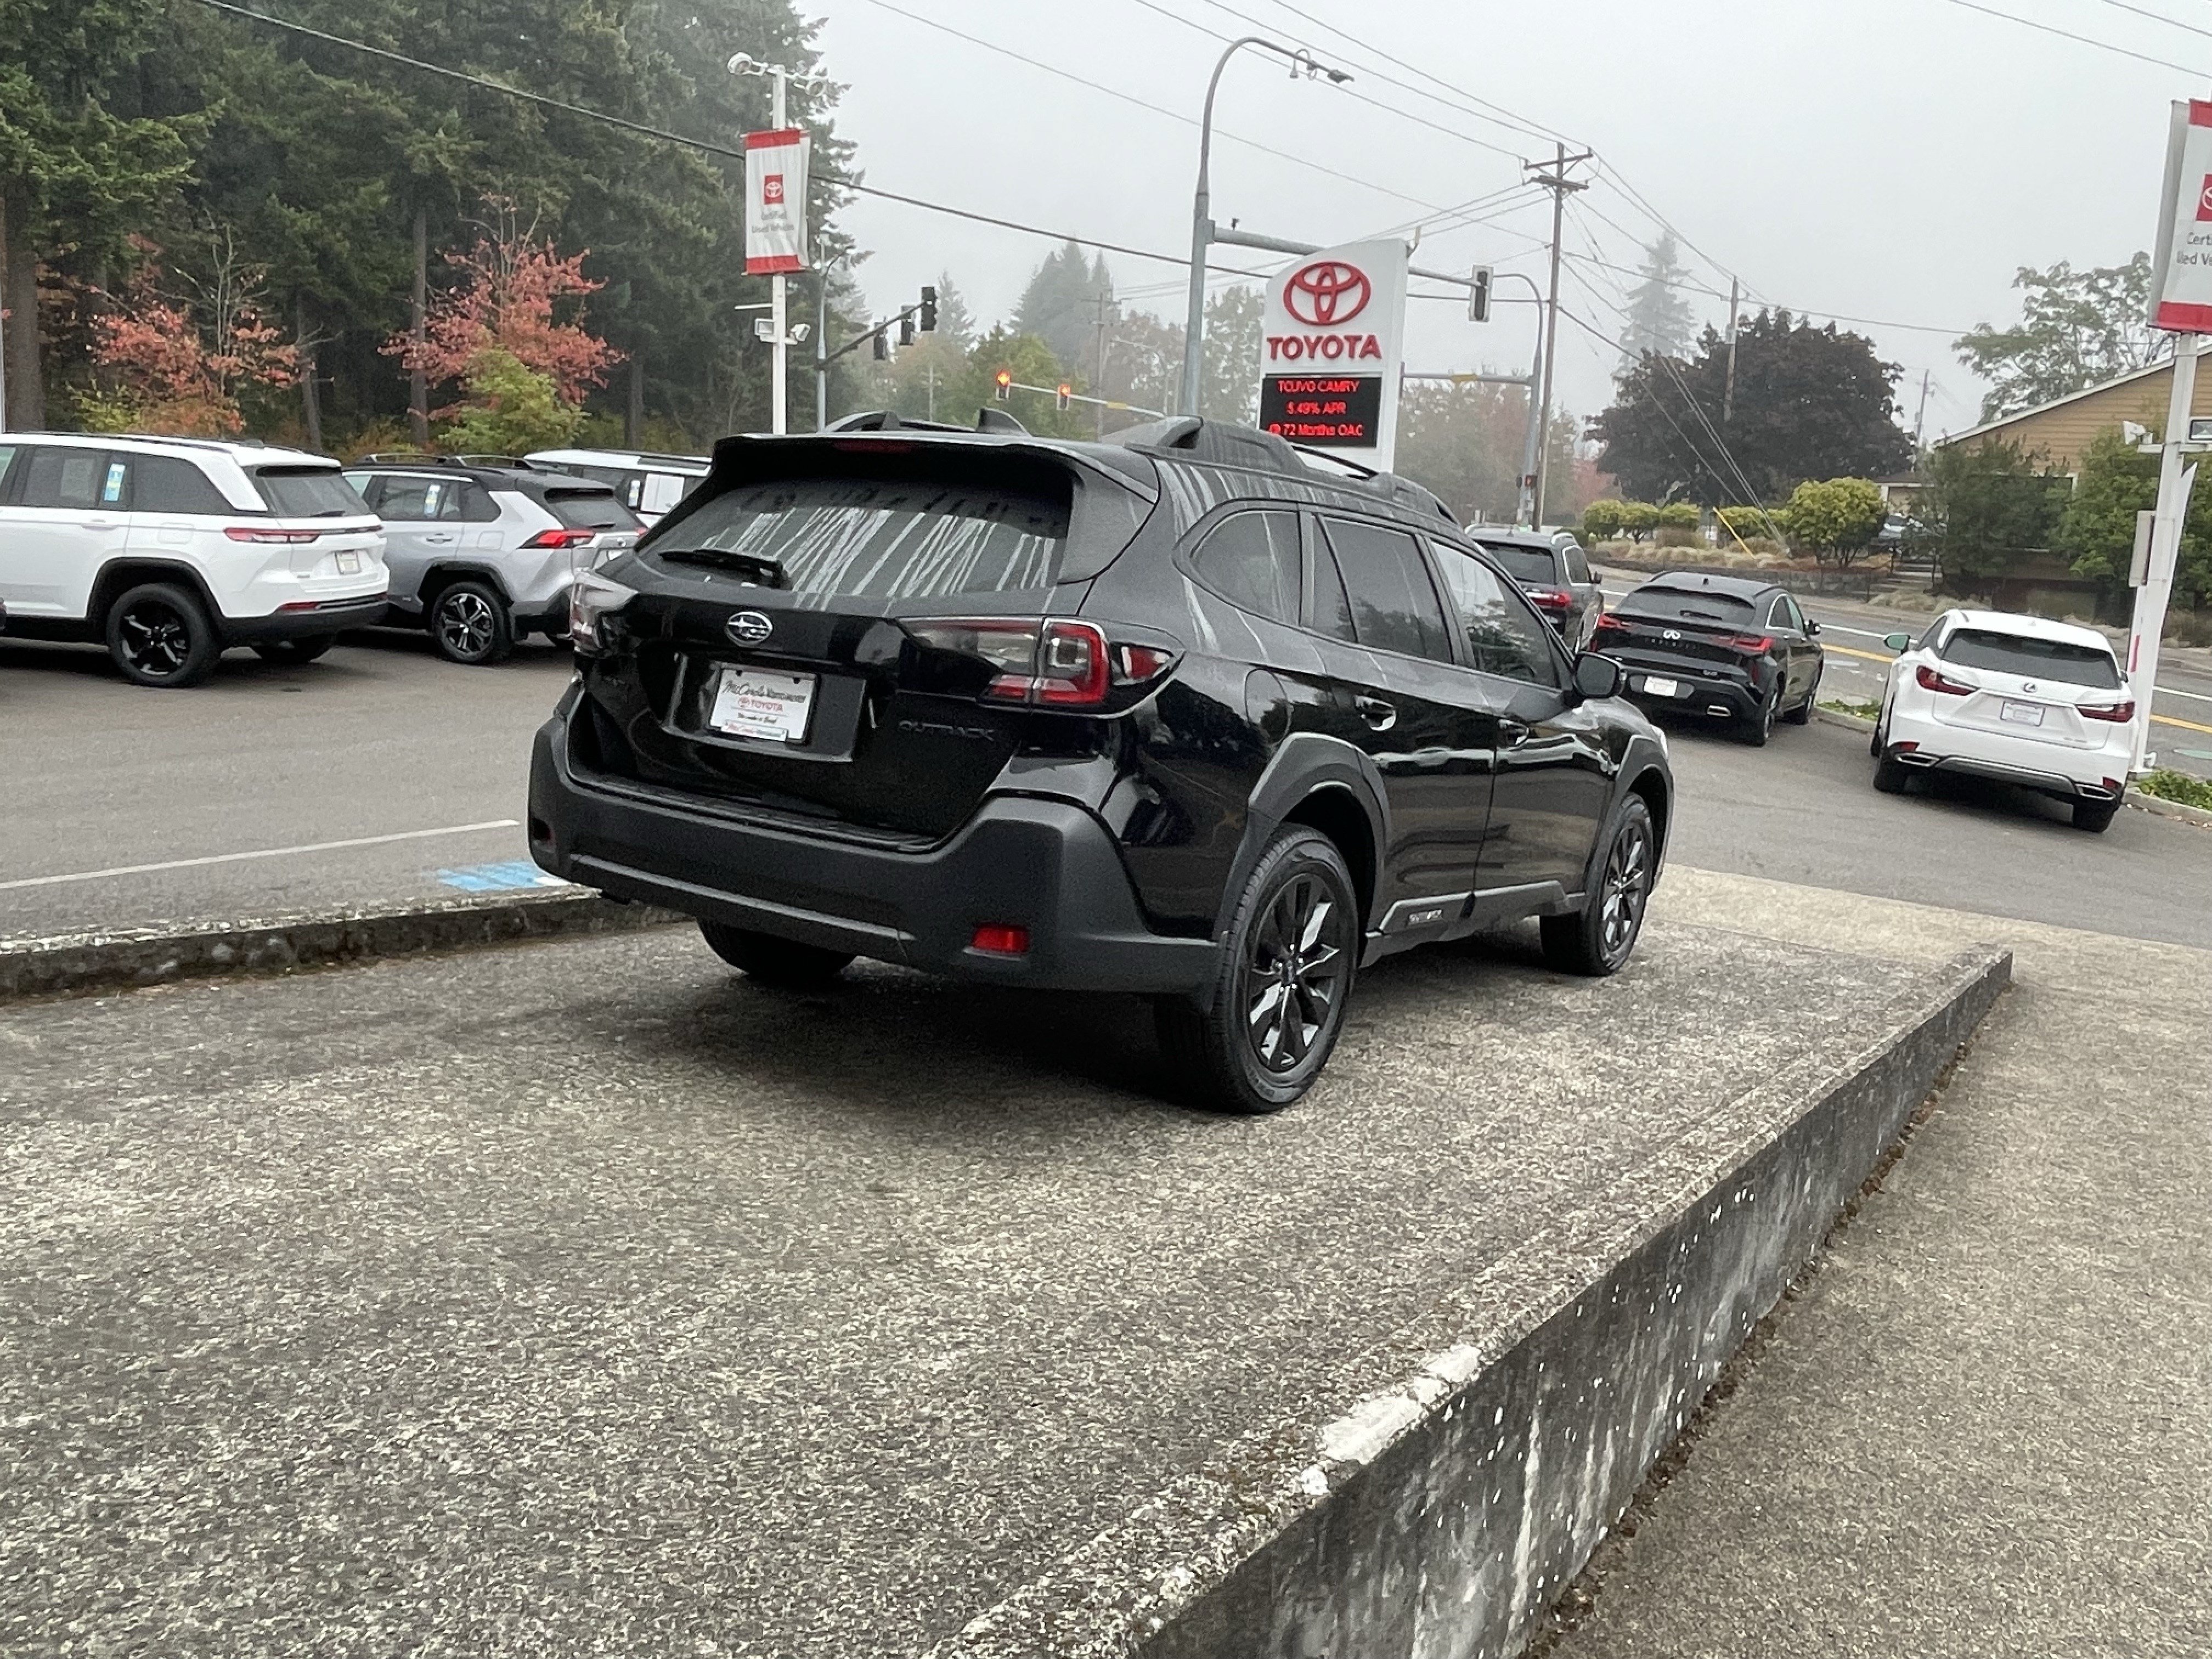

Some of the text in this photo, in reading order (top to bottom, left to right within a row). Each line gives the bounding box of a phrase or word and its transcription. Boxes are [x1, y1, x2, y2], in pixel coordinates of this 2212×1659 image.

[1267, 335, 1382, 360] TOYOTA
[1283, 424, 1296, 436] 72
[1338, 424, 1364, 437] OAC
[751, 699, 783, 712] TOYOTA
